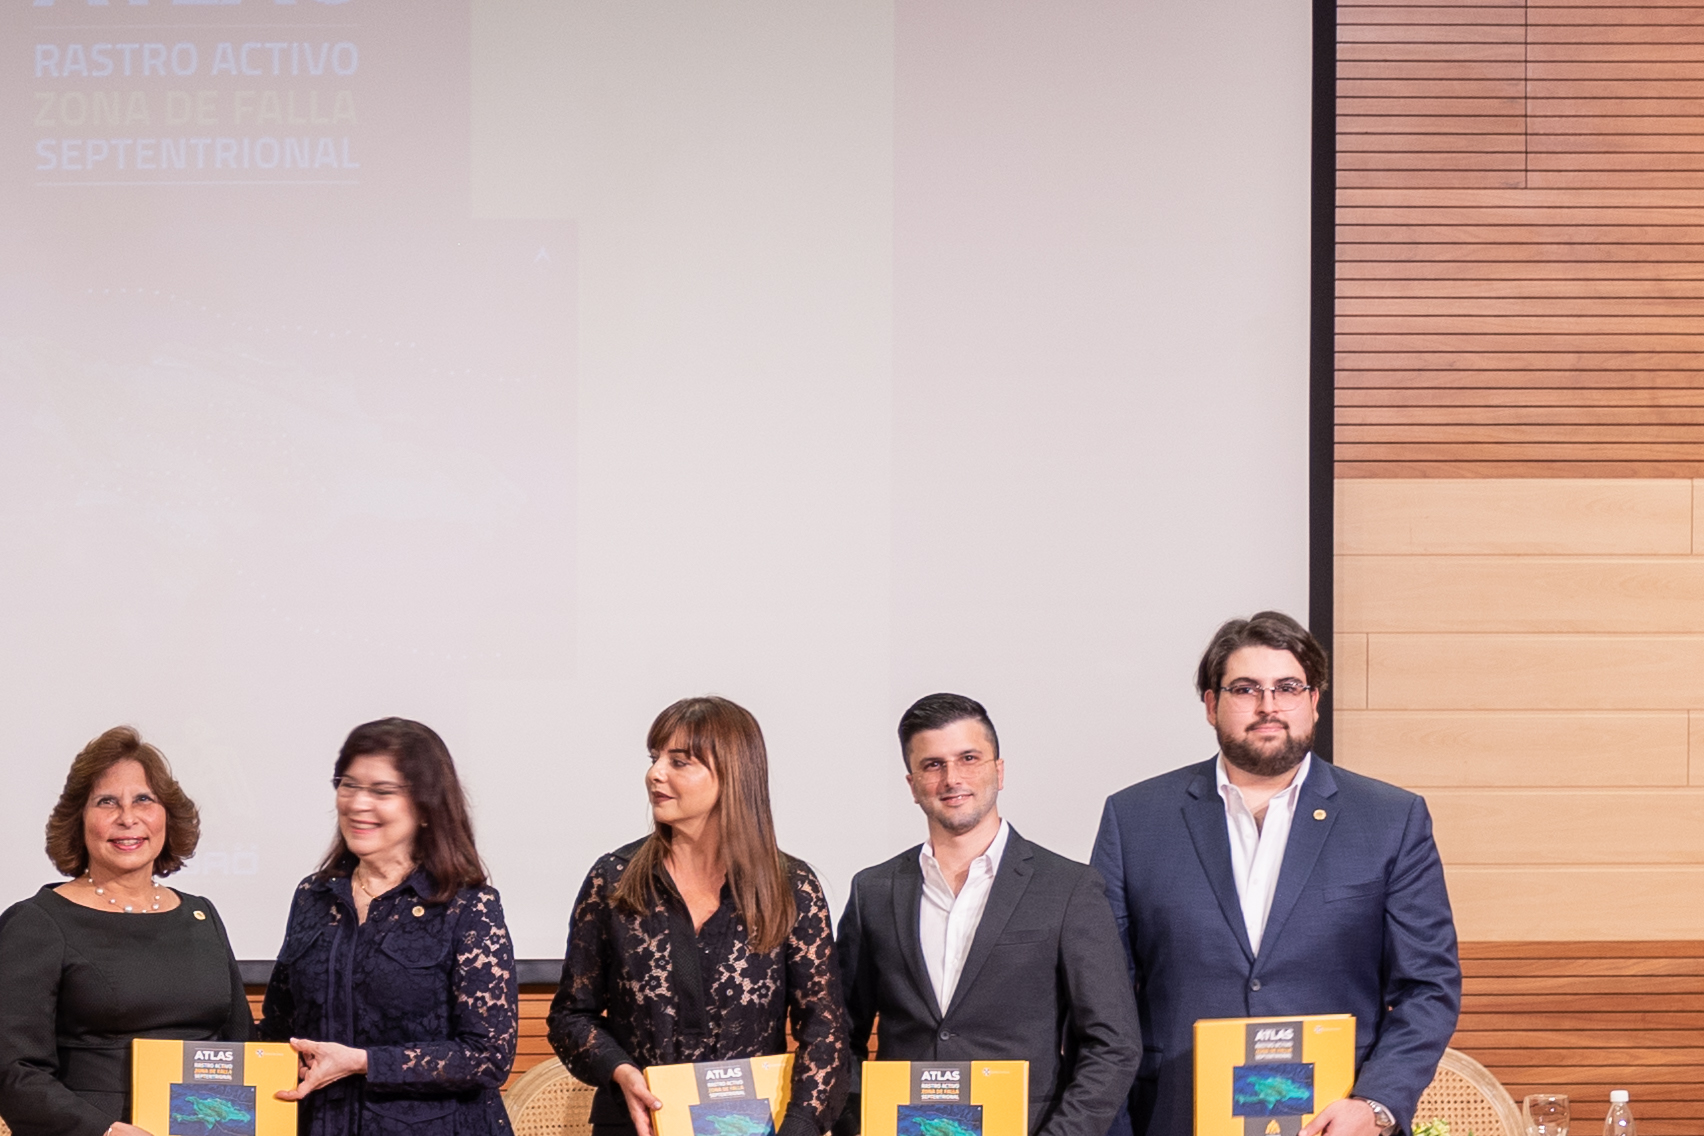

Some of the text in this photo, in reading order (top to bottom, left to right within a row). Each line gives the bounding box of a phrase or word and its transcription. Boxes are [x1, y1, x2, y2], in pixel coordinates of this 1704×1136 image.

[33, 42, 360, 77] RASTRO ACTIVO
[33, 90, 359, 127] ZONA DE FALLA
[34, 136, 360, 171] SEPTENTRIONAL
[1254, 1028, 1294, 1041] ATLAS
[194, 1050, 233, 1061] ATLAS
[706, 1068, 742, 1080] ATLAS
[921, 1070, 960, 1081] ATLAS
